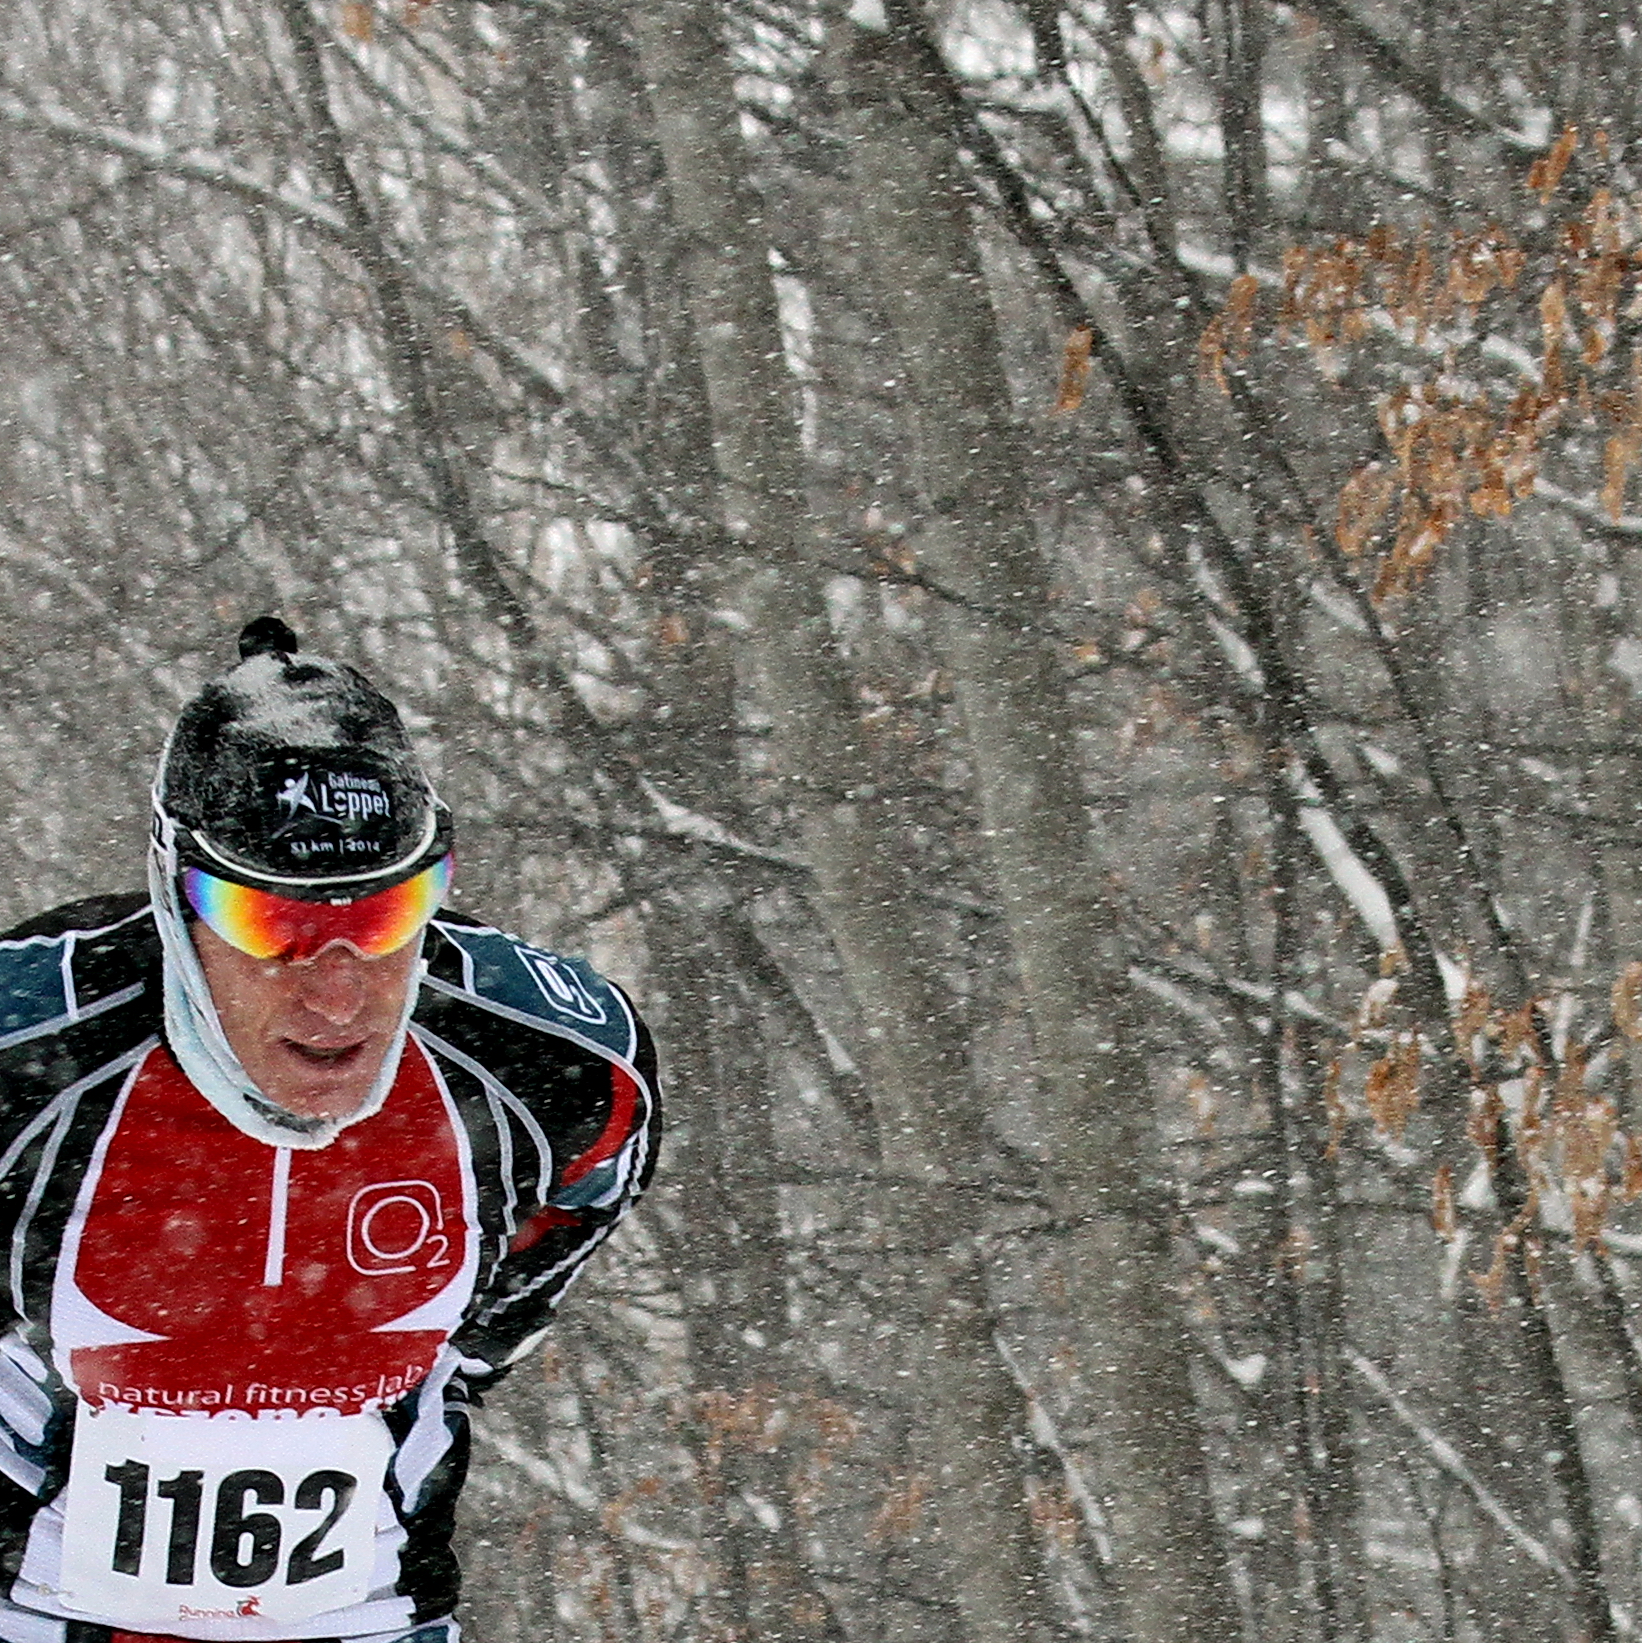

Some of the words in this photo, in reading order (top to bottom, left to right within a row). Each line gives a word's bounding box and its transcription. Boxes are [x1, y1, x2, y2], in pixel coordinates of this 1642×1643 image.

[320, 782, 391, 821] Loppet
[361, 1195, 451, 1269] O2
[98, 1380, 234, 1405] natural
[245, 1383, 367, 1404] fitness
[376, 1364, 423, 1399] lab
[104, 1458, 358, 1588] 1162
